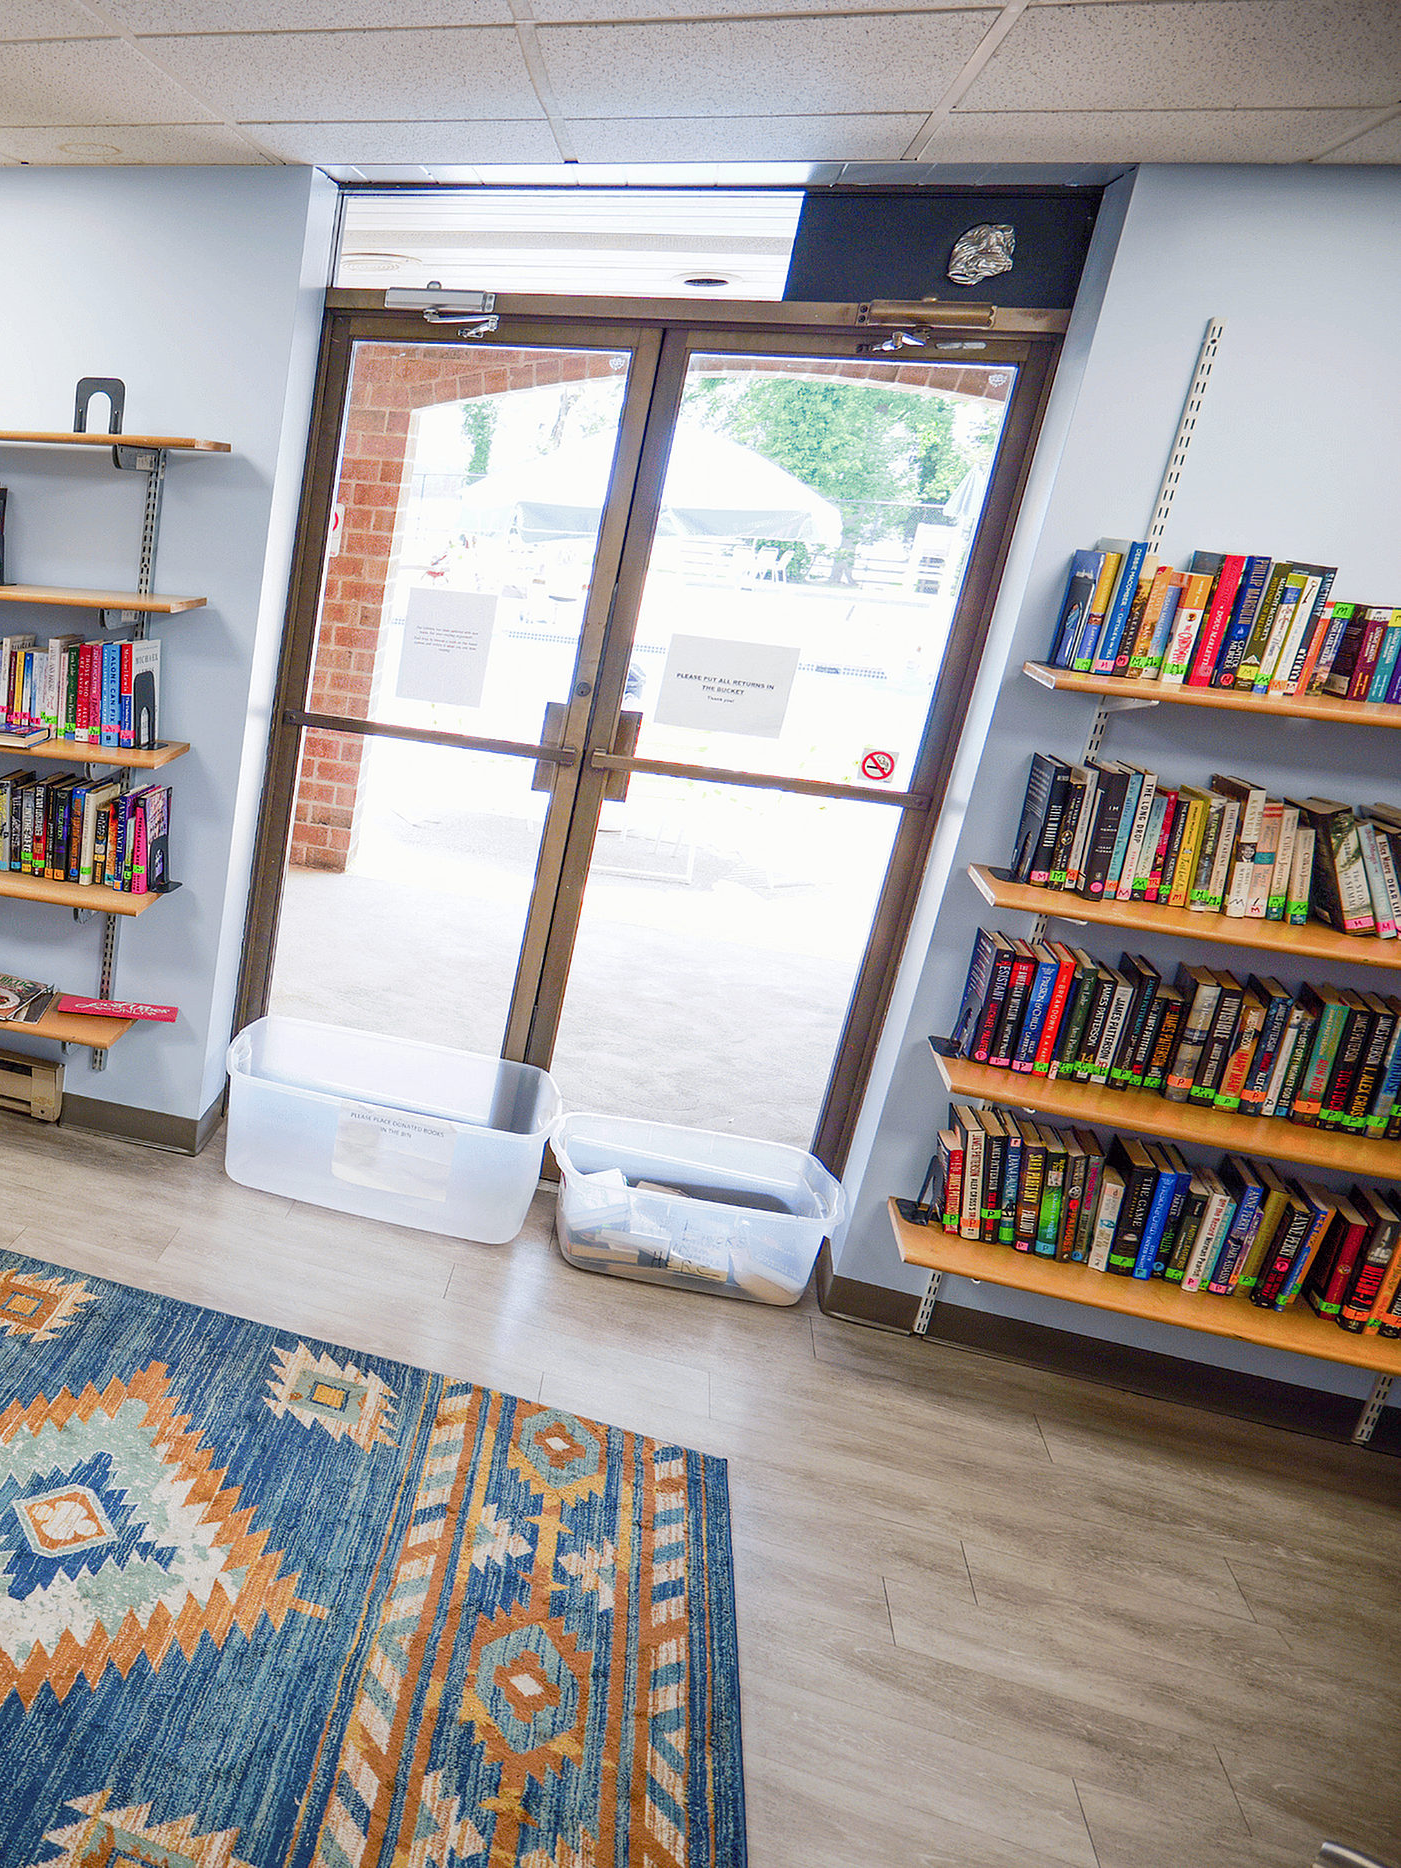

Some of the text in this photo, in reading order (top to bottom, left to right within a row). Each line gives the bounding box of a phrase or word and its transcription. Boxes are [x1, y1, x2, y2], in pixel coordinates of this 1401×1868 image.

[1119, 548, 1142, 606] DEBBIE MACOMBER
[1237, 559, 1269, 625] PHILLIP MARGOLIN
[1313, 572, 1336, 617] SANCTUARY
[1200, 610, 1223, 665] DOUG MARLETTE
[1223, 639, 1238, 669] MURDER
[1230, 640, 1245, 668] CAPITOL
[677, 673, 702, 681] PLEASE
[732, 680, 763, 689] RETURNS
[717, 687, 745, 695] BUCKET
[115, 800, 127, 853] JANE LYNCH
[1133, 783, 1153, 843] THE LONG DROP
[1172, 813, 1186, 851] ARRANGEMENT
[1387, 878, 1400, 918] DEAR LIFE
[991, 959, 1011, 1001] RESISTANT
[1006, 970, 1027, 1021] AMERICAN MISSION
[1047, 983, 1066, 1032] BREAKDOWN
[1086, 983, 1112, 1047] JAMES PATTERSON
[1098, 997, 1125, 1059] JAMES PATTERSON
[1212, 996, 1240, 1040] INVISIBLE
[1151, 1012, 1178, 1067] JAMES PATTERSON
[1225, 1051, 1249, 1093] MARY MARY
[1308, 1059, 1328, 1096] RUN ROSE
[1334, 1068, 1352, 1090] TICK
[1348, 1073, 1373, 1117] ALEX CROS
[350, 1112, 445, 1137] PLEASE PLACE DONATED BOOKS
[388, 1128, 400, 1136] THE
[401, 1130, 413, 1138] BIN
[988, 1140, 1002, 1191] JAMES PATTERSON
[1023, 1153, 1042, 1204] SARA PARETSKY
[1019, 1208, 1035, 1234] FALLOUT
